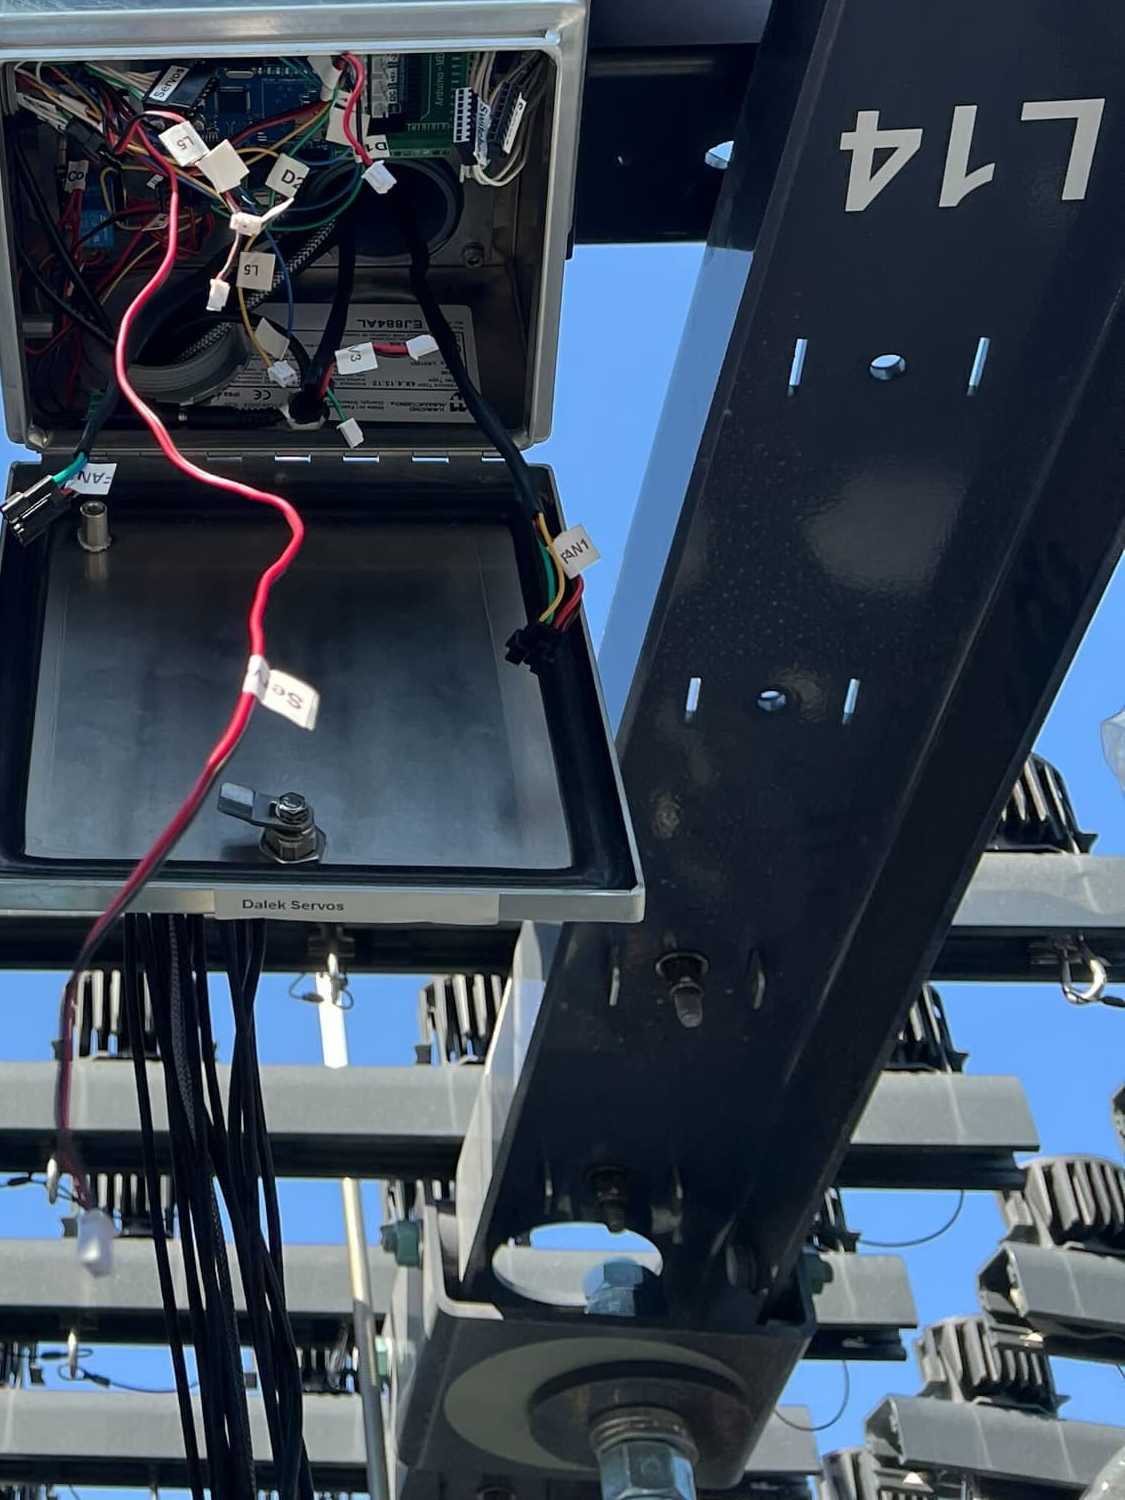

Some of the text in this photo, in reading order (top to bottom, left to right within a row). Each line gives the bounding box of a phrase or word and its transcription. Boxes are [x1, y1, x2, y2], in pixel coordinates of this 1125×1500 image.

[176, 135, 196, 151] L5
[839, 98, 1106, 213] L14
[243, 263, 259, 277] L5
[356, 318, 423, 330] EJ884AL
[560, 538, 589, 564] FAN1
[242, 899, 344, 911] Dalek Servos
